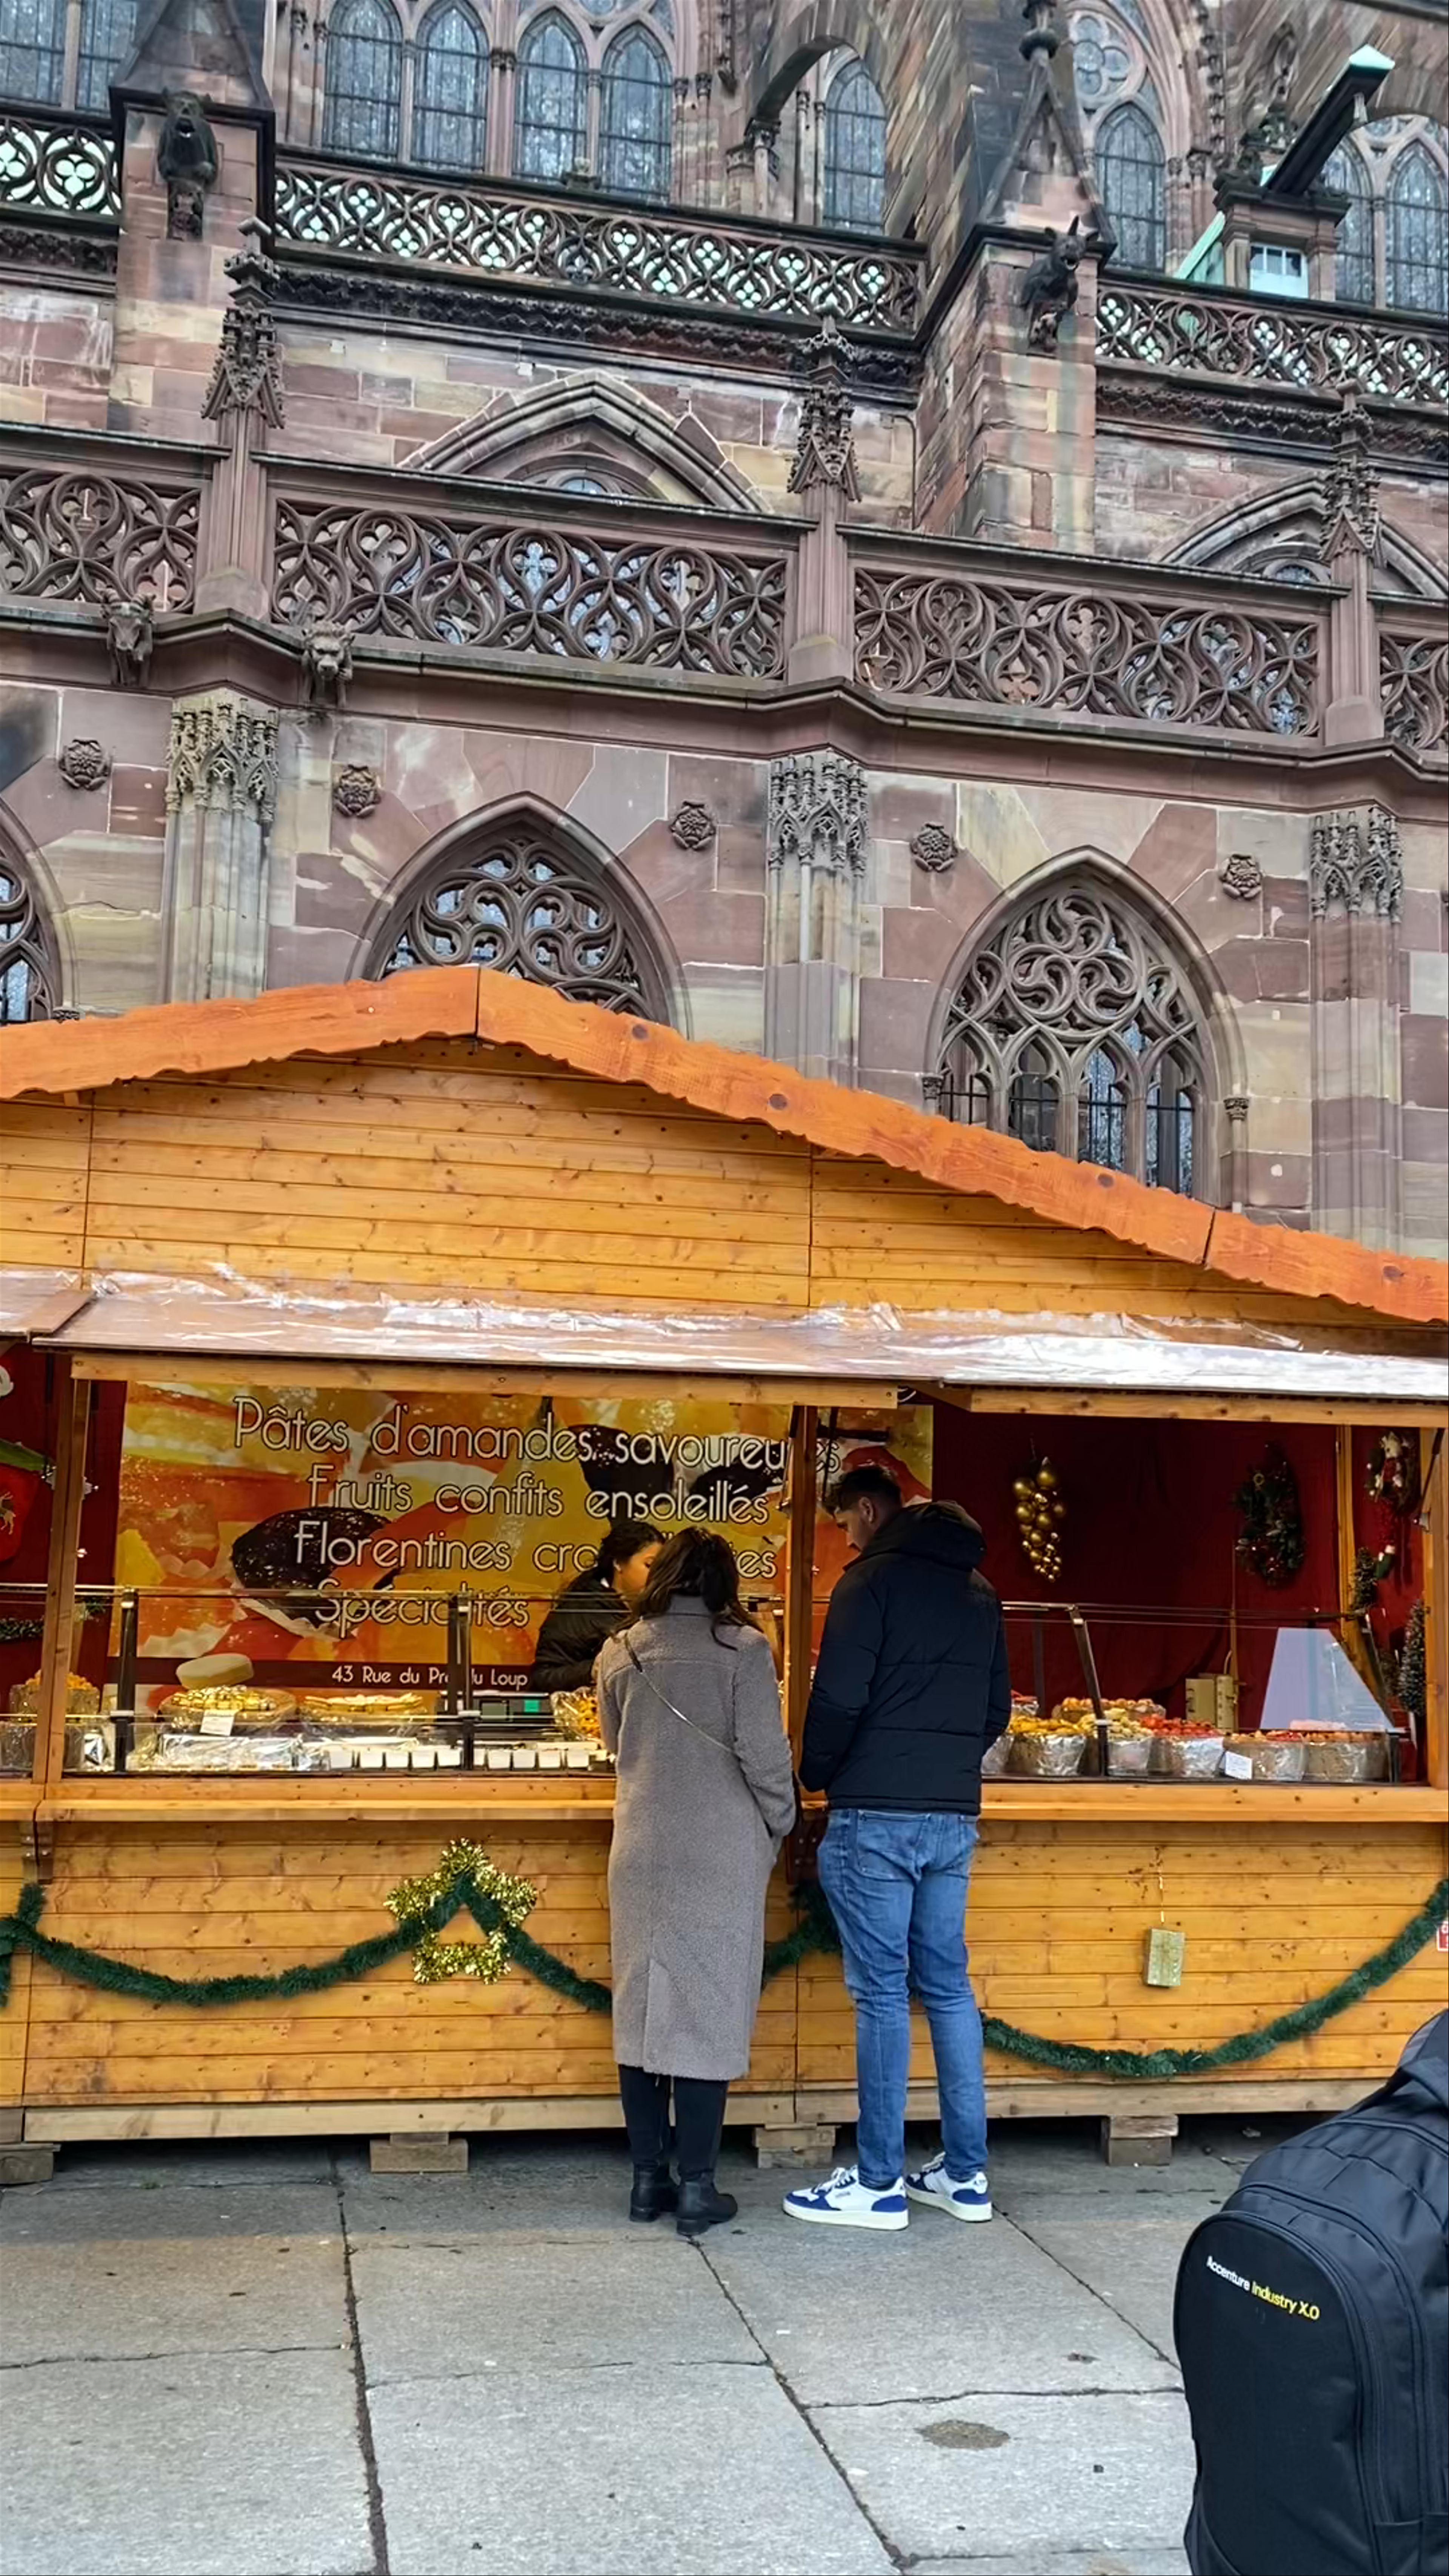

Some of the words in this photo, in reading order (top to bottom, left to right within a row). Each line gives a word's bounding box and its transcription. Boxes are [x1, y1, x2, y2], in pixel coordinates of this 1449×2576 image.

[234, 1397, 349, 1452] Pâtes
[372, 1404, 593, 1461] d'amandes
[308, 1463, 412, 1511] Fruits
[435, 1472, 564, 1516] confits
[586, 1478, 769, 1524] ensoleillés
[294, 1521, 512, 1570] Florentines
[332, 1665, 354, 1682] 43
[362, 1666, 391, 1683] Rue
[399, 1667, 420, 1684] du
[491, 1668, 528, 1691] Loup
[1206, 2256, 1250, 2291] Accenture
[1251, 2281, 1297, 2314] Industry
[1298, 2301, 1320, 2320] X.0
